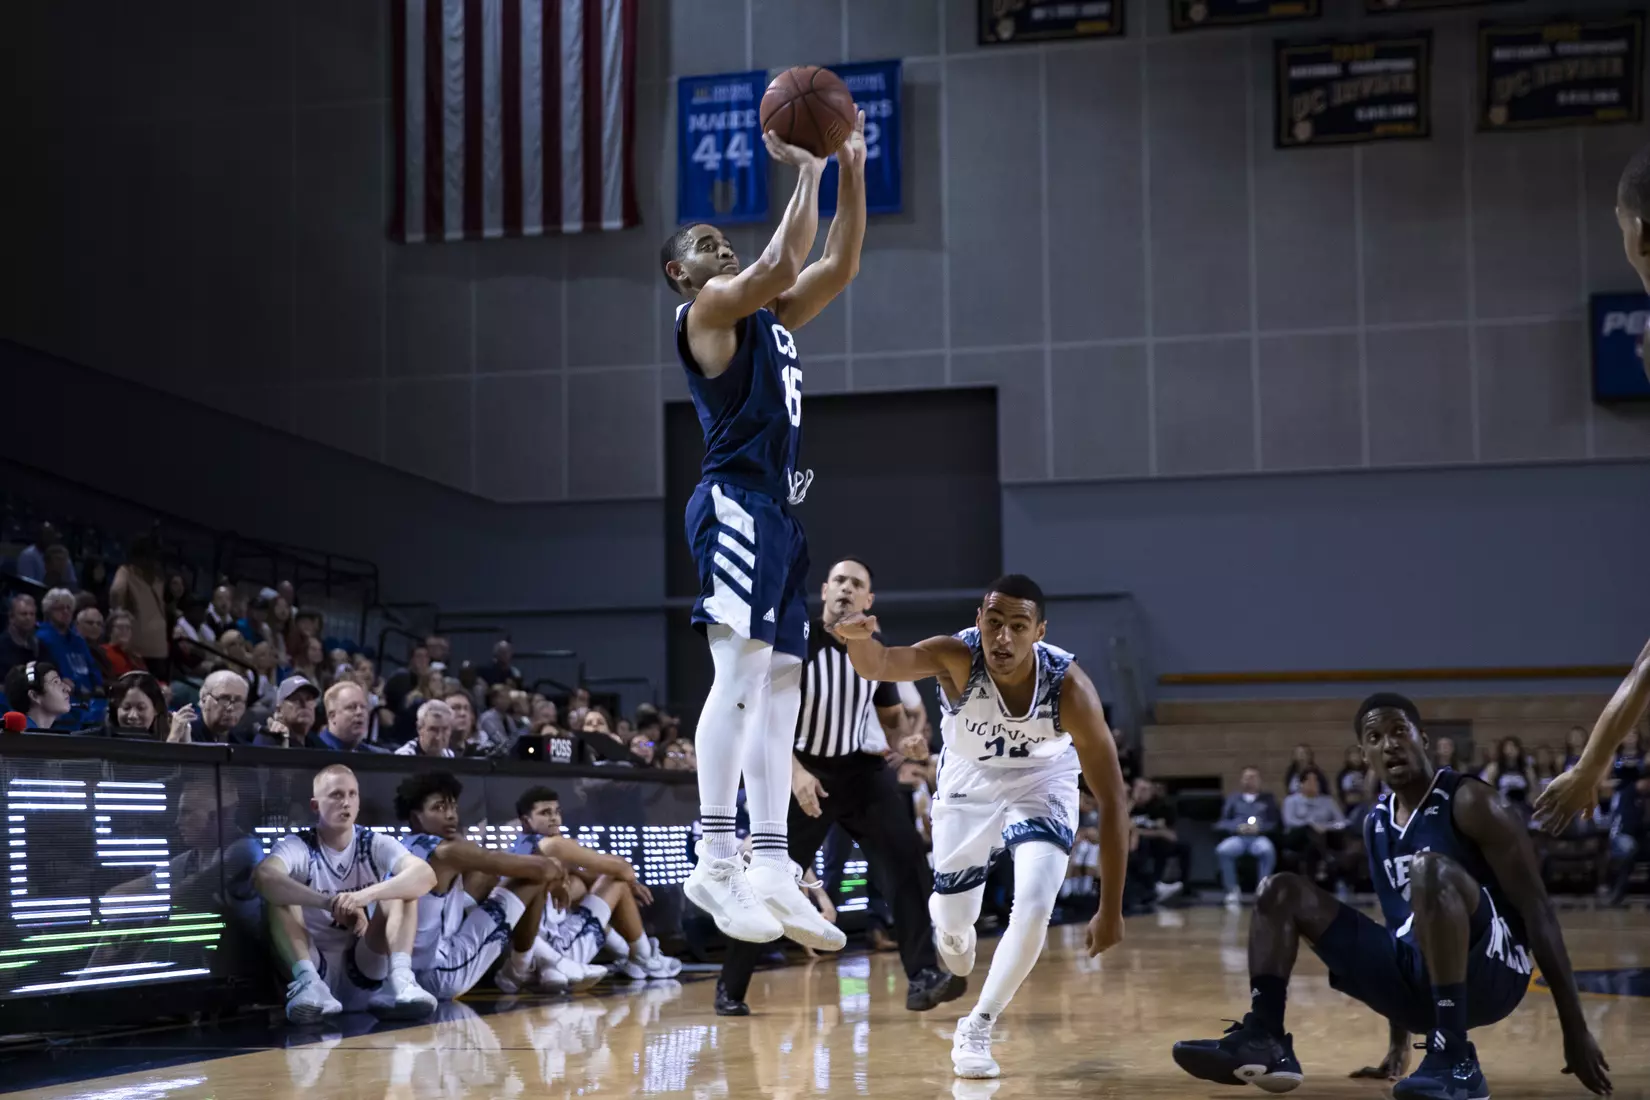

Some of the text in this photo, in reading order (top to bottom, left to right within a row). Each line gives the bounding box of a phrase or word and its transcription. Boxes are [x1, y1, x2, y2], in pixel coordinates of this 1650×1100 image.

[692, 133, 752, 170] 44
[782, 365, 802, 428] 15
[965, 718, 988, 736] UC
